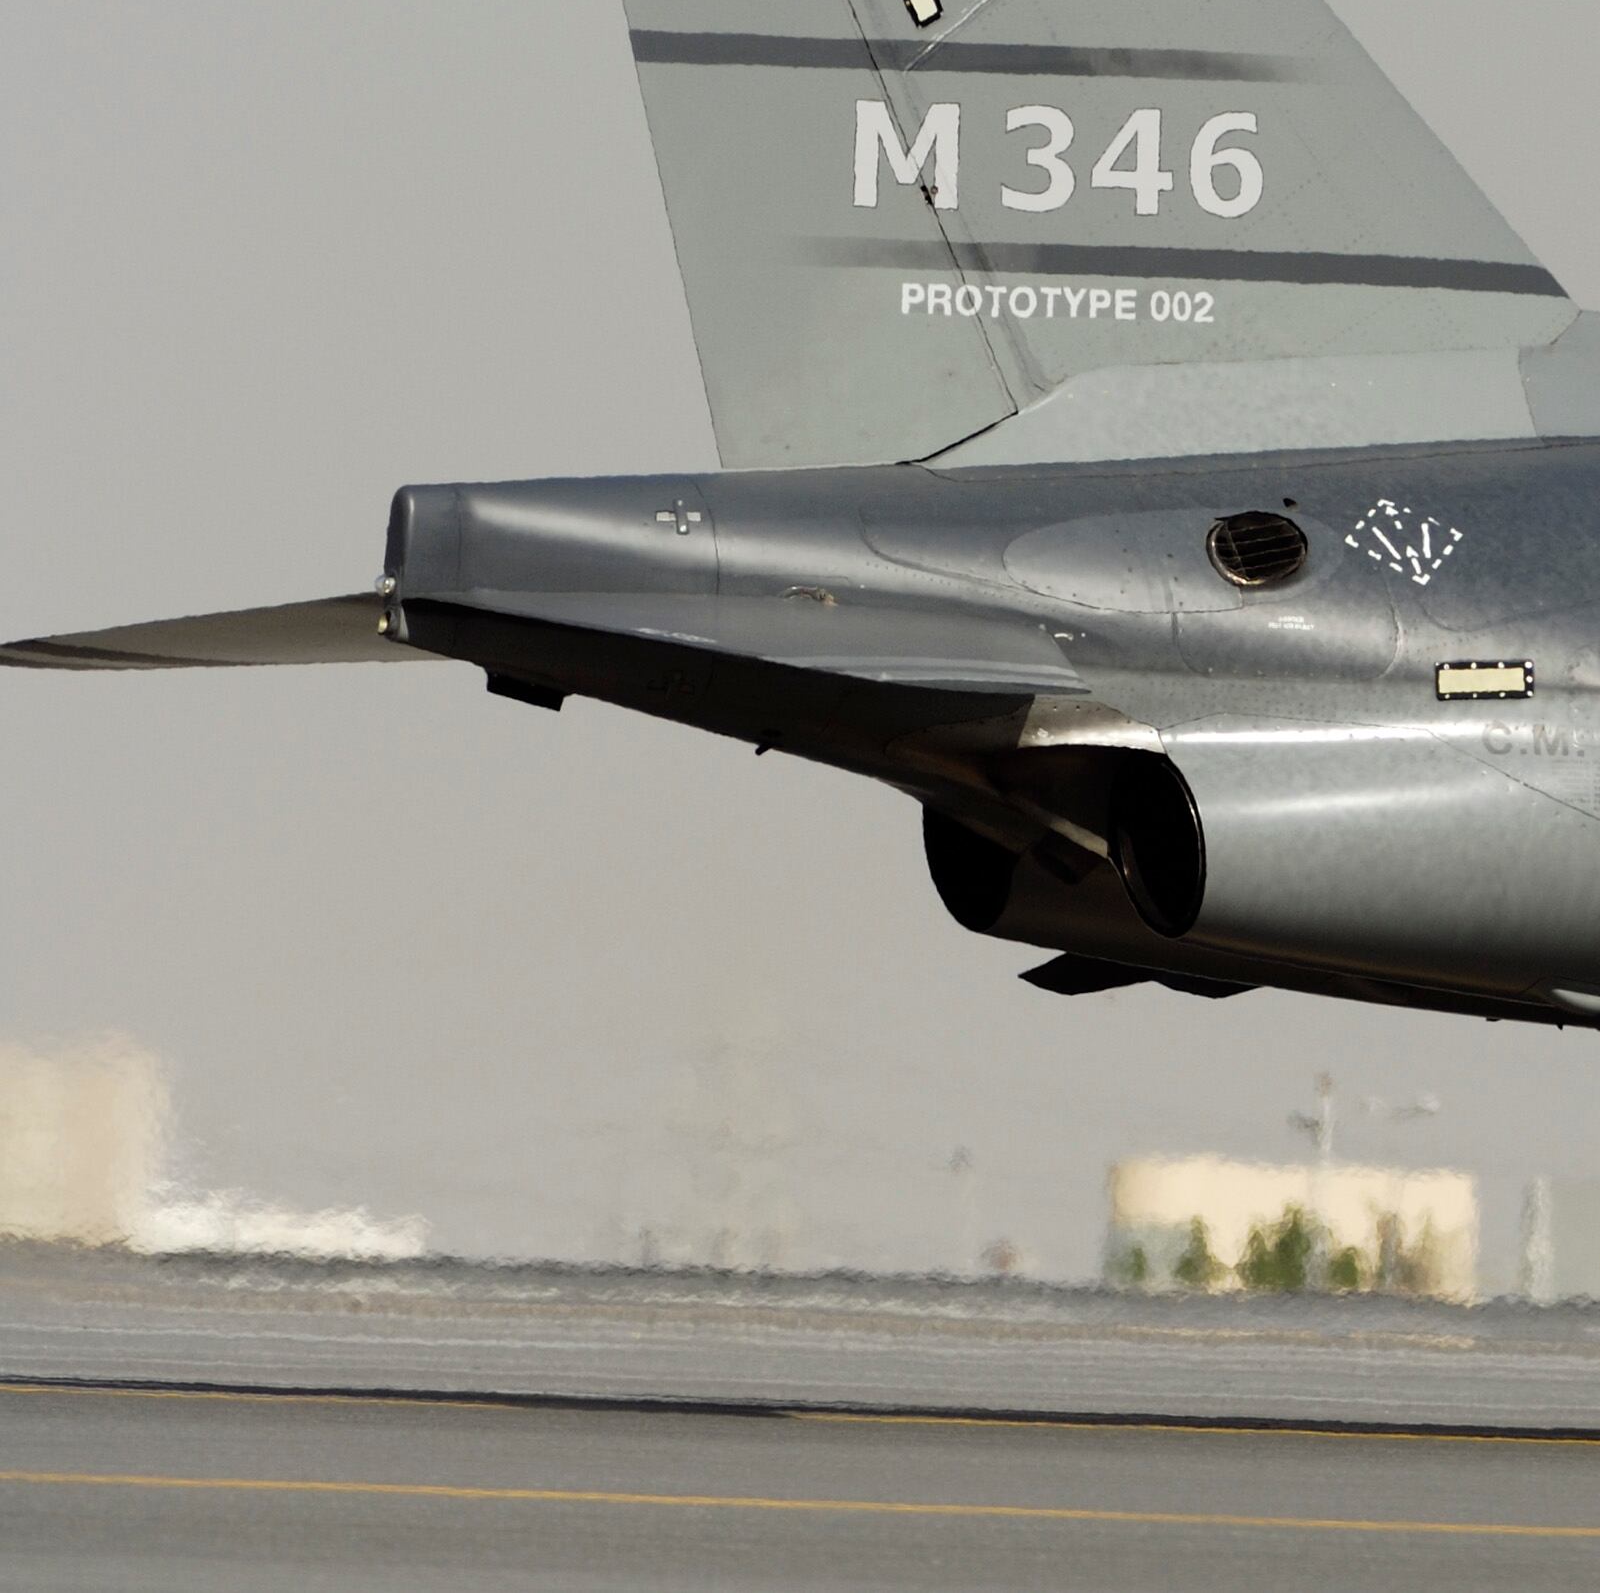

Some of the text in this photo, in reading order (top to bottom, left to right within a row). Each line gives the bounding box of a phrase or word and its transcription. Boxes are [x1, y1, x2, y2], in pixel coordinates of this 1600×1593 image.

[853, 99, 1264, 218] M 346
[901, 282, 1215, 323] PROTOTYPE 002
